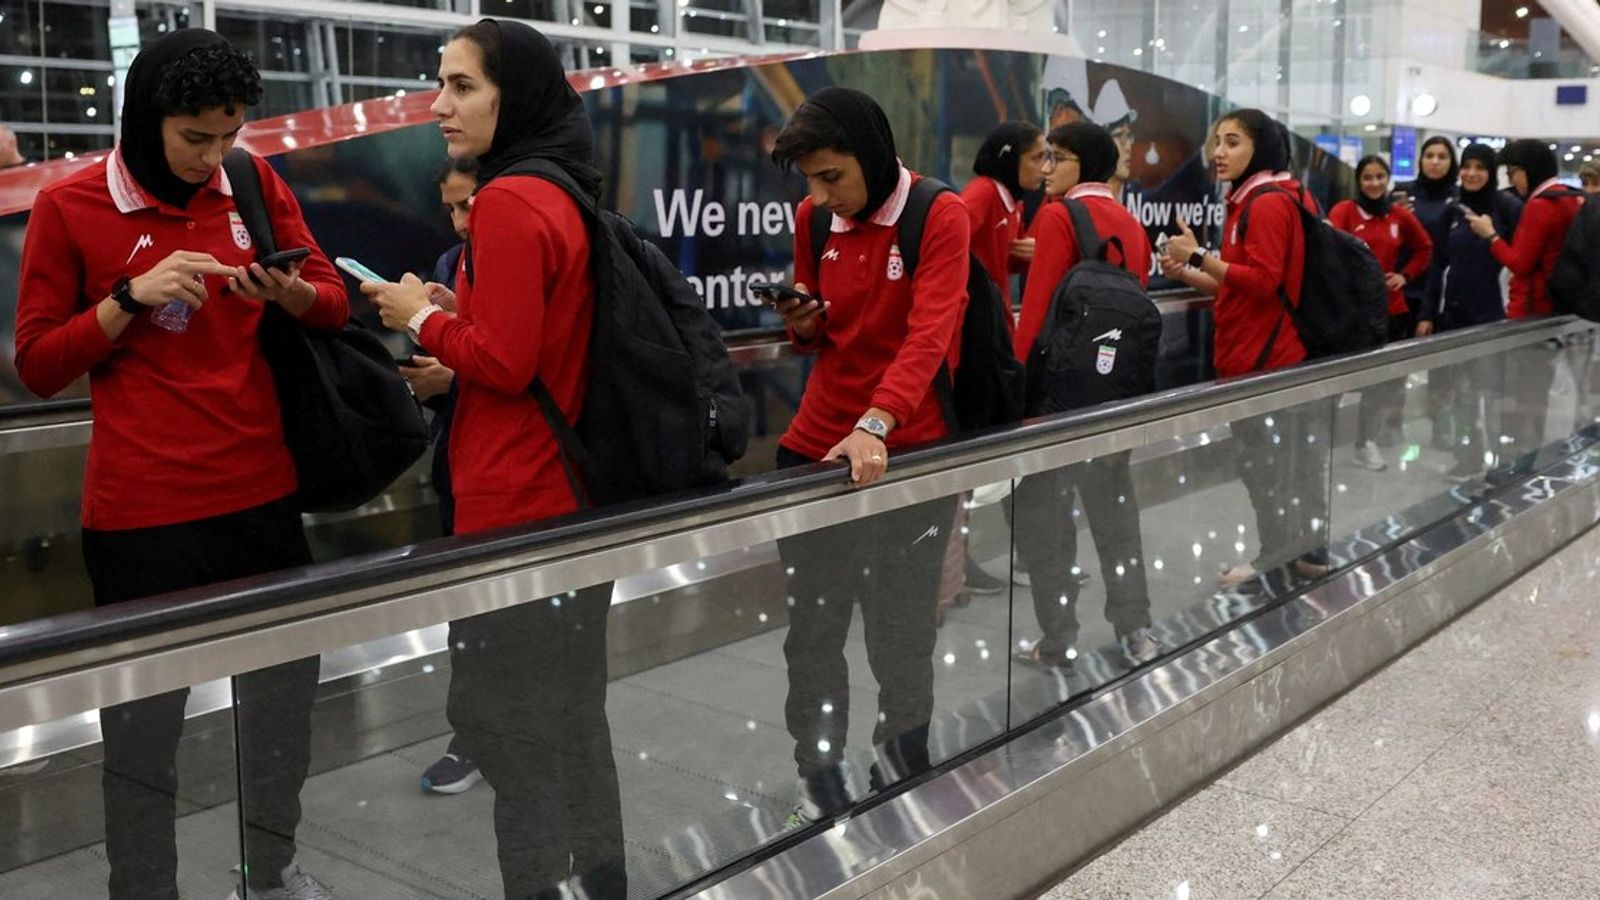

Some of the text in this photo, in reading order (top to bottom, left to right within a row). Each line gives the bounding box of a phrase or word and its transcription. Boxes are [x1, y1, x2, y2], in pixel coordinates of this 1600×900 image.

[653, 188, 725, 238] We
[1127, 192, 1224, 227] Now we're
